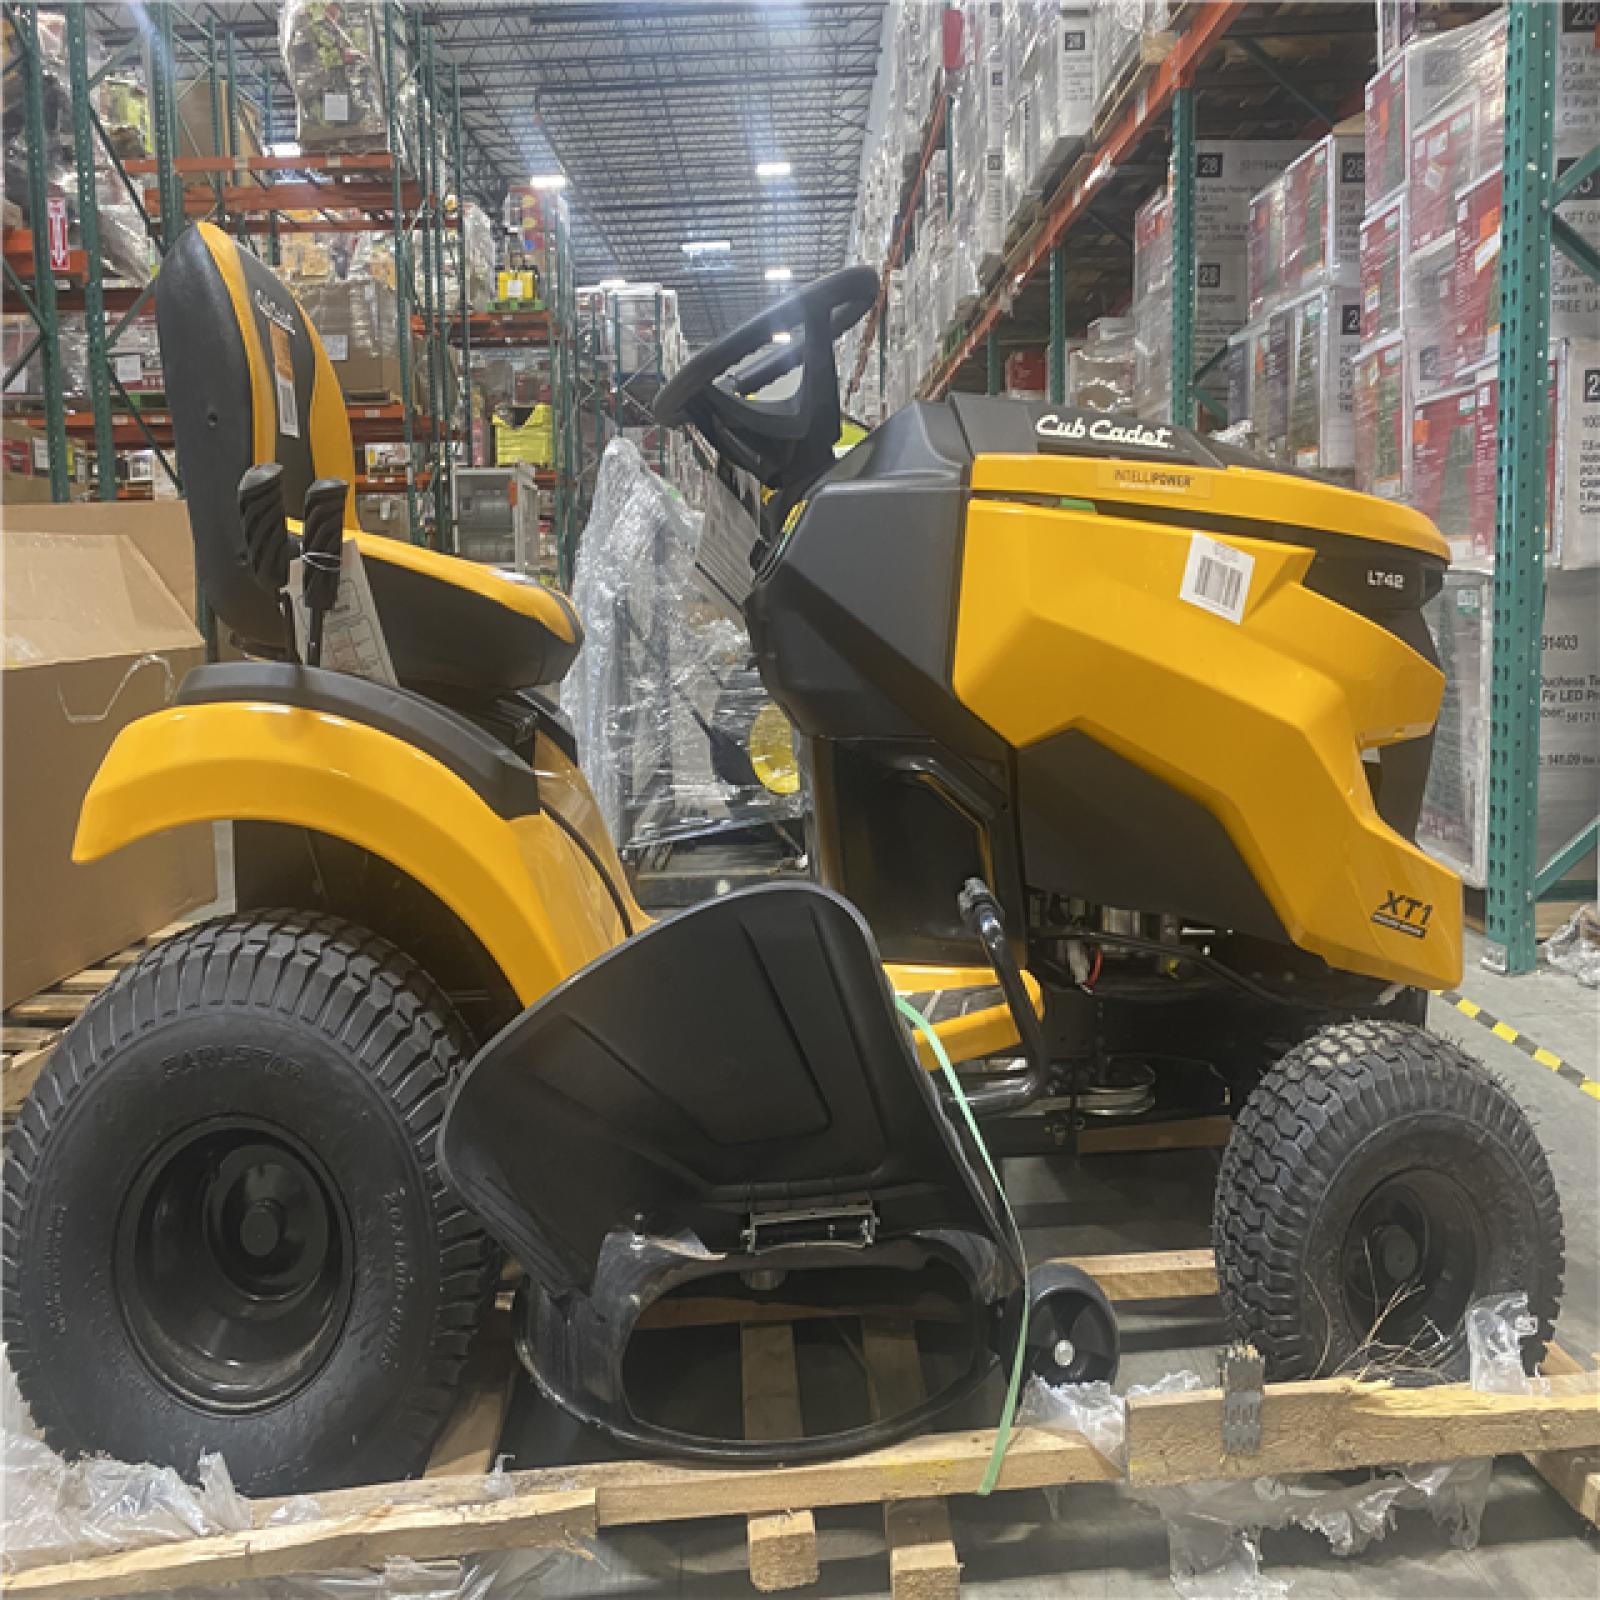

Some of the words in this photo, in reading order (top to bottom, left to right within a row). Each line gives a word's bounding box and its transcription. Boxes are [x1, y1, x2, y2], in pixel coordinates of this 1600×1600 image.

[1035, 414, 1086, 438] Cub
[1089, 419, 1173, 448] Cadet
[1367, 569, 1404, 589] LT42
[1560, 689, 1583, 703] LED
[1376, 889, 1434, 926] XT1
